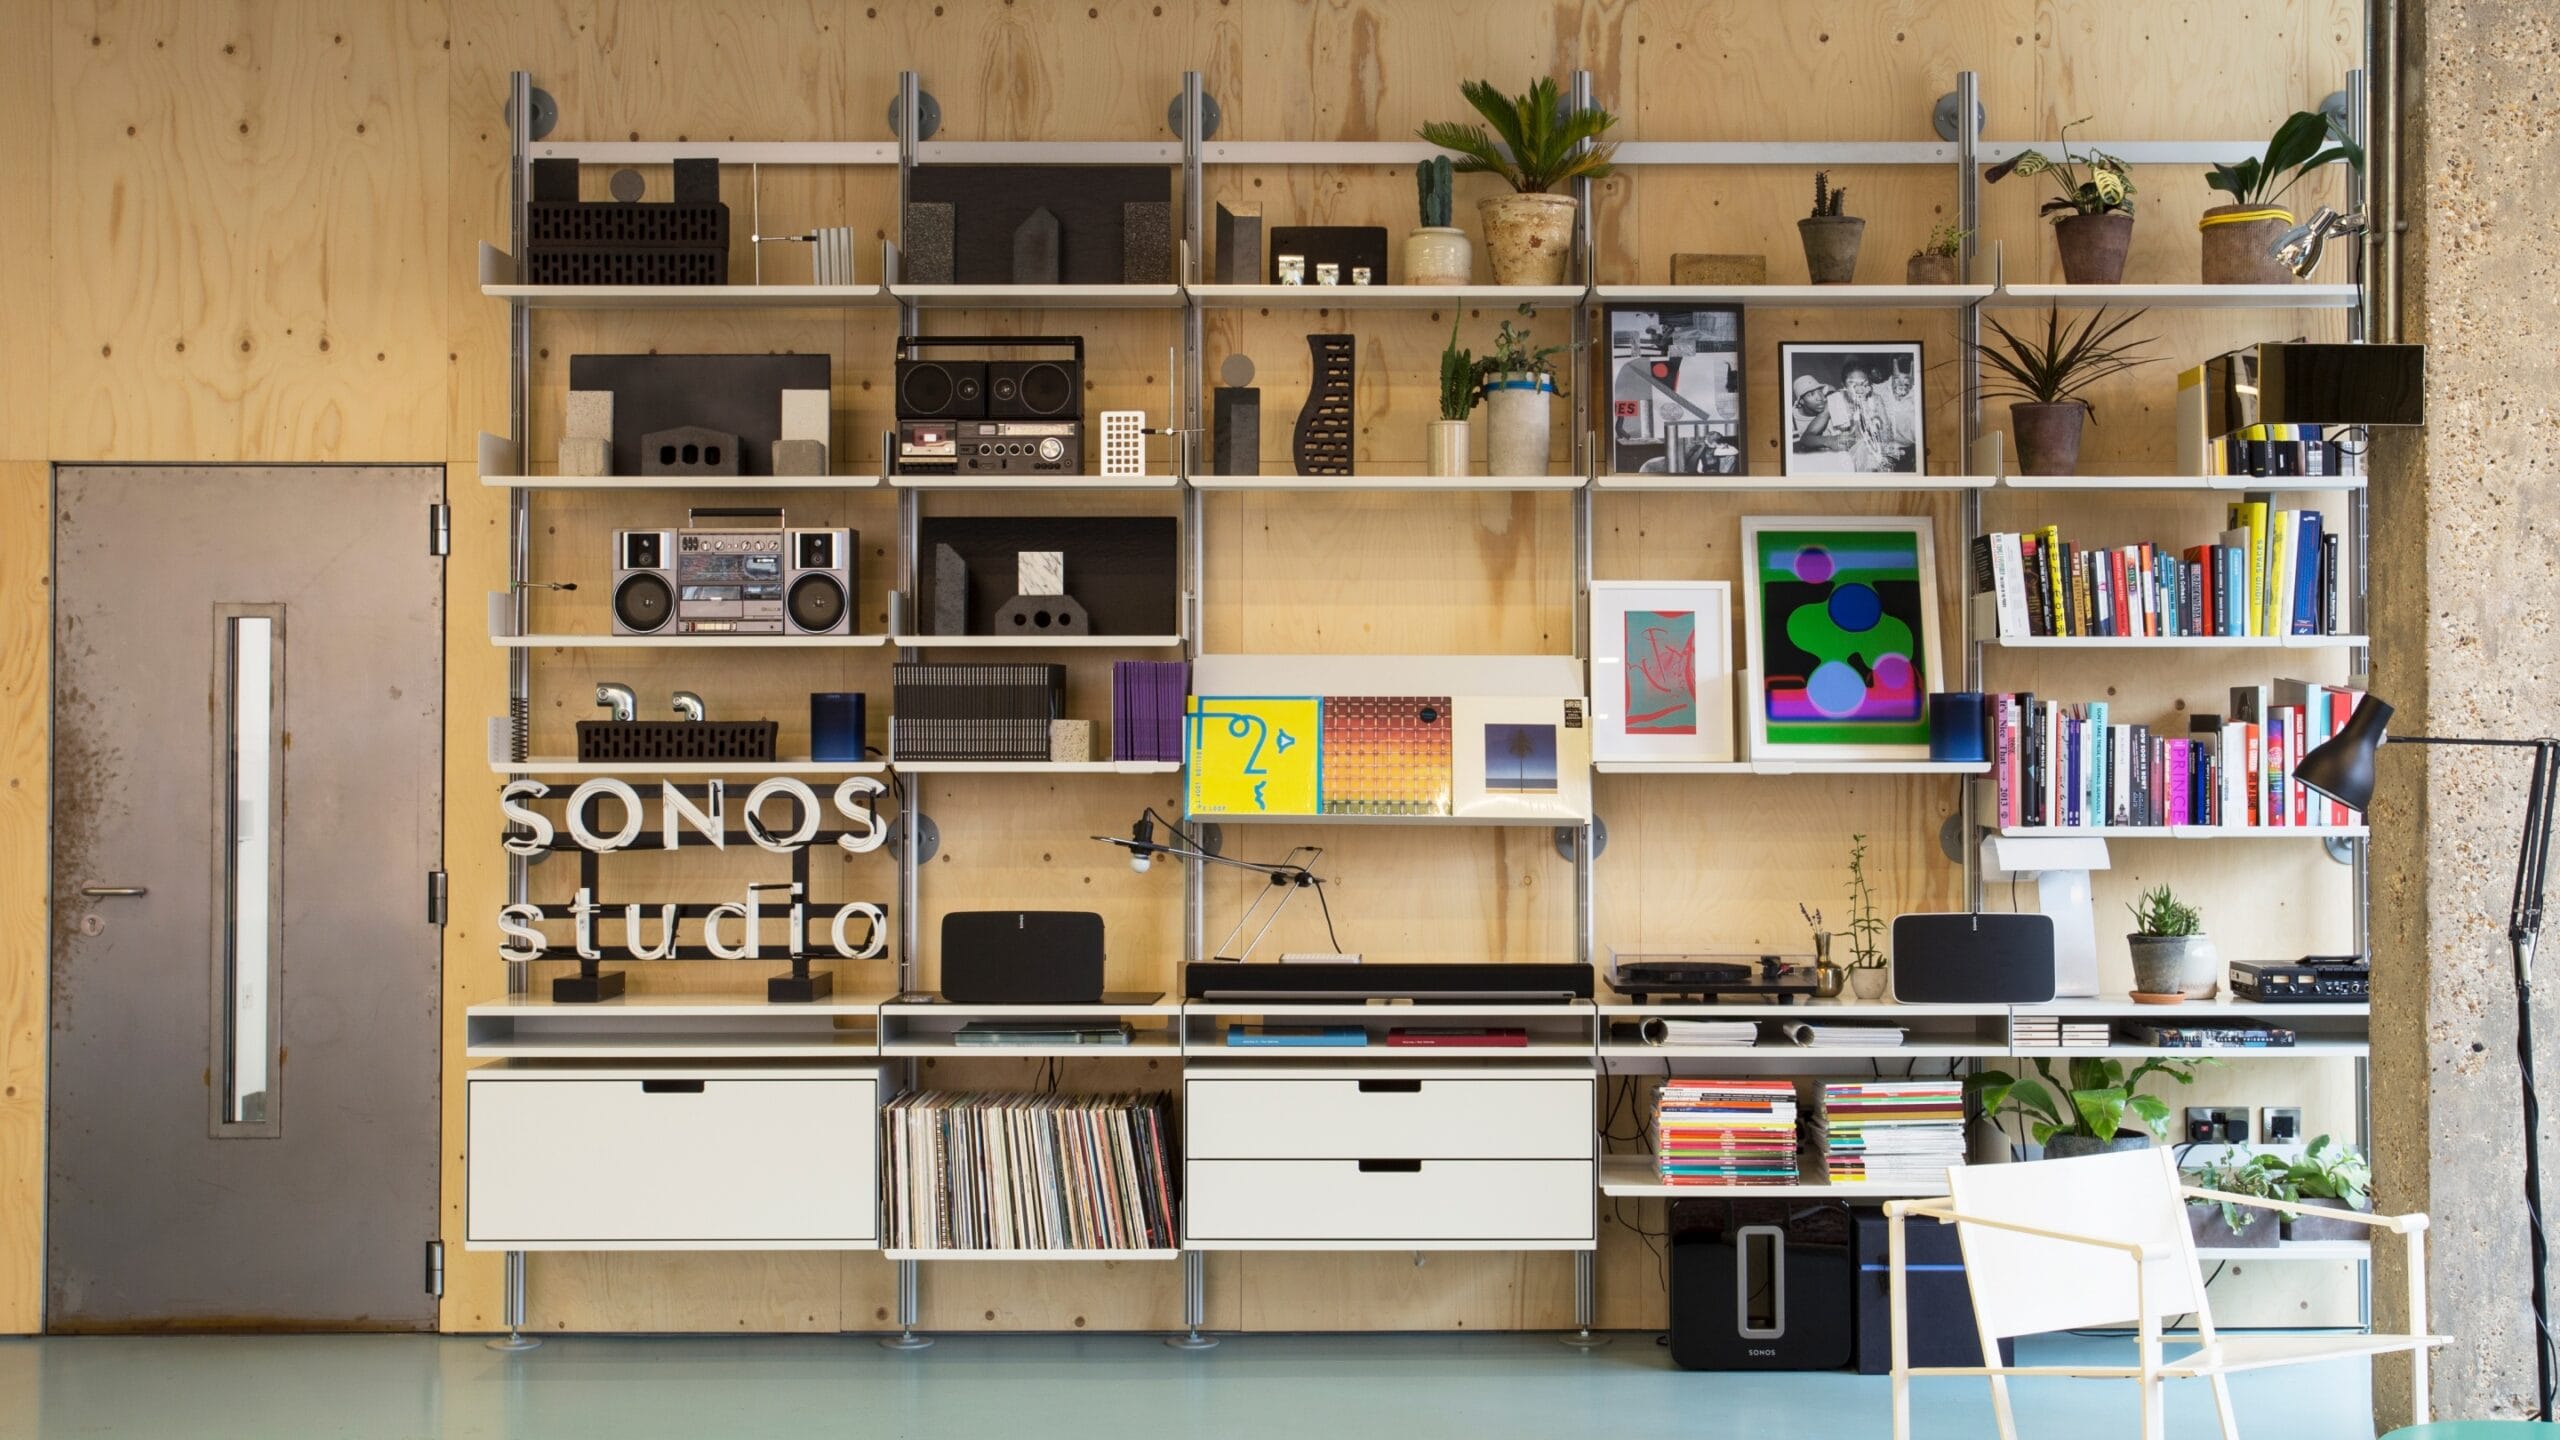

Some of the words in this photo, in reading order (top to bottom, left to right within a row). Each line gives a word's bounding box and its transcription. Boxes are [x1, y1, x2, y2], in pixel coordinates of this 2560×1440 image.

[2256, 539, 2264, 573] SPACES
[2128, 564, 2136, 591] SOUND
[2254, 575, 2262, 606] LIQUID
[2000, 700, 2008, 713] It's
[2000, 719, 2008, 738] Nice
[2000, 745, 2008, 765] That
[2000, 787, 2008, 807] 2013
[2173, 749, 2186, 819] PRINCE
[500, 776, 888, 855] SONOS
[497, 882, 888, 961] studio
